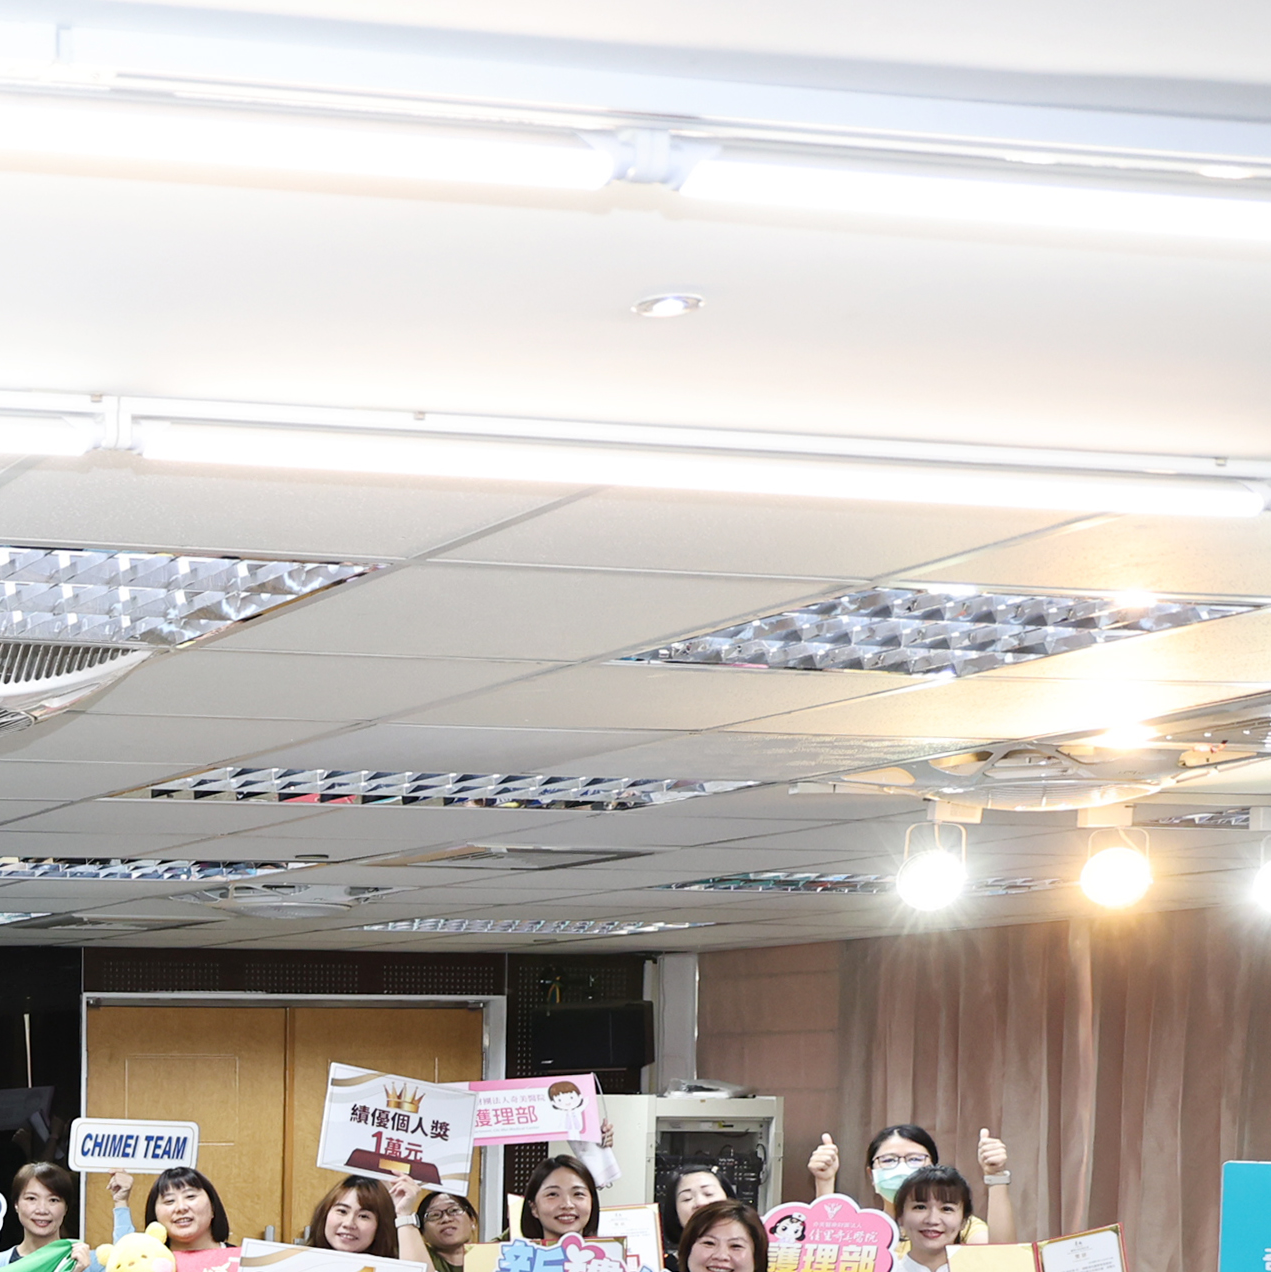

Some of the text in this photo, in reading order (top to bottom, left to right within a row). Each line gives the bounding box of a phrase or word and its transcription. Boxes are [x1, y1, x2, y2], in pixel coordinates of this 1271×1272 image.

[349, 1103, 451, 1142] 績優個人獎
[475, 1105, 538, 1128] 護理部
[80, 1133, 188, 1160] CHIMEI TEAM
[371, 1131, 424, 1162] 1萬元
